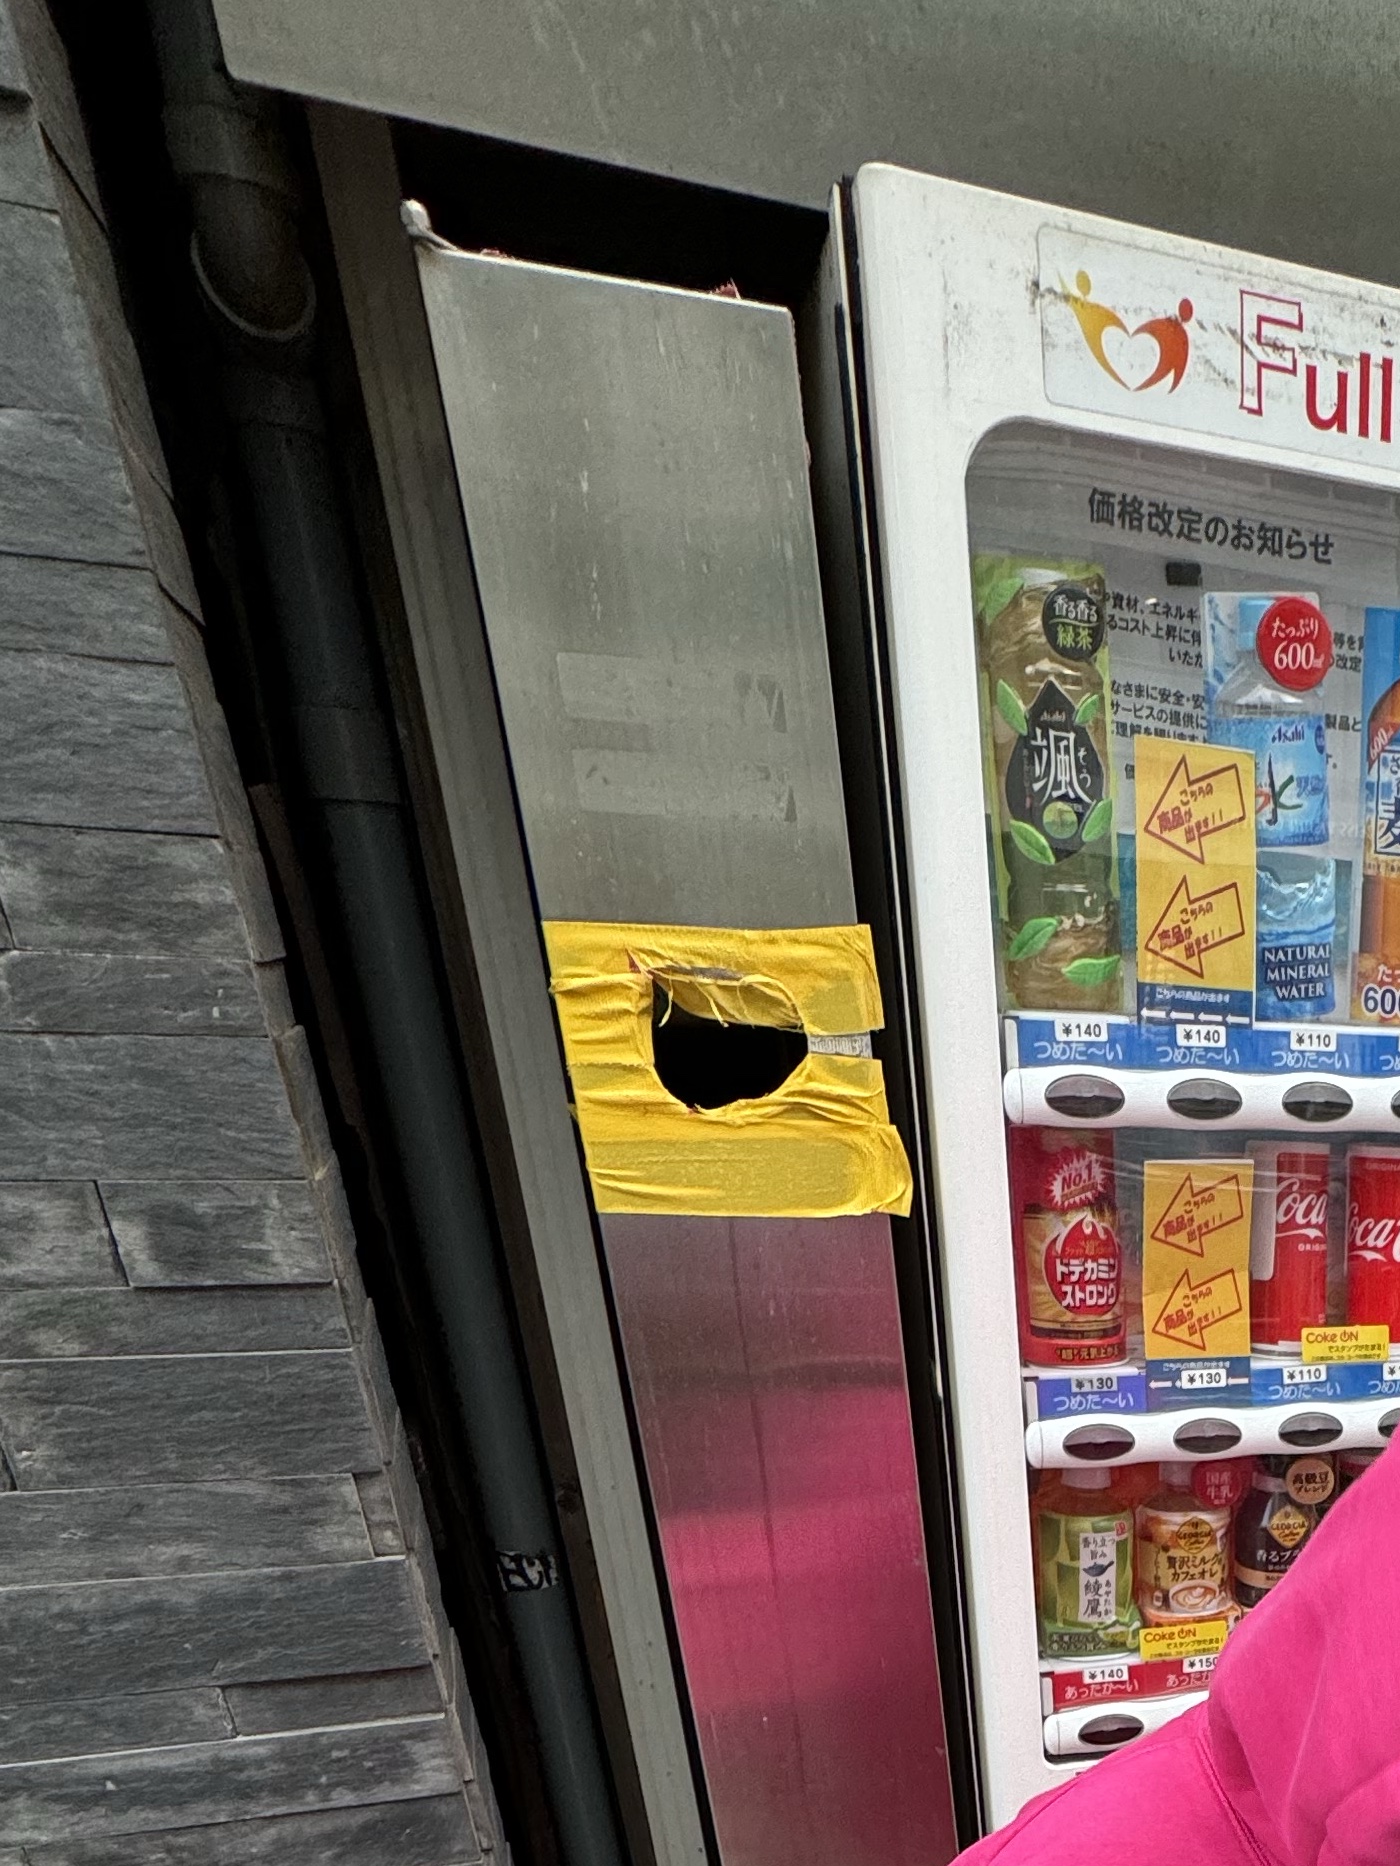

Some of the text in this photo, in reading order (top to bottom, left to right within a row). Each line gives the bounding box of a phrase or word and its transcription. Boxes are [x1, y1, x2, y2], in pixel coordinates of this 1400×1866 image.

[1239, 289, 1393, 443] Full
[1087, 487, 1335, 566] 価格改定のお知らせ
[1272, 617, 1319, 639] たっぷり
[1056, 625, 1093, 650] 緑茶
[1266, 962, 1330, 981] MINERAL
[1275, 982, 1325, 999] WATER
[1062, 1024, 1102, 1038] ¥140
[1183, 1029, 1221, 1045] ¥140
[1295, 1033, 1331, 1048] ¥110
[1055, 1258, 1117, 1283] ドデカミン
[1306, 1332, 1337, 1344] Coke
[1187, 1371, 1222, 1386] ¥130
[1287, 1367, 1322, 1382] ¥110
[1075, 1376, 1113, 1391] ¥130
[1144, 1631, 1175, 1643] Coke
[1088, 1669, 1124, 1681] ¥140
